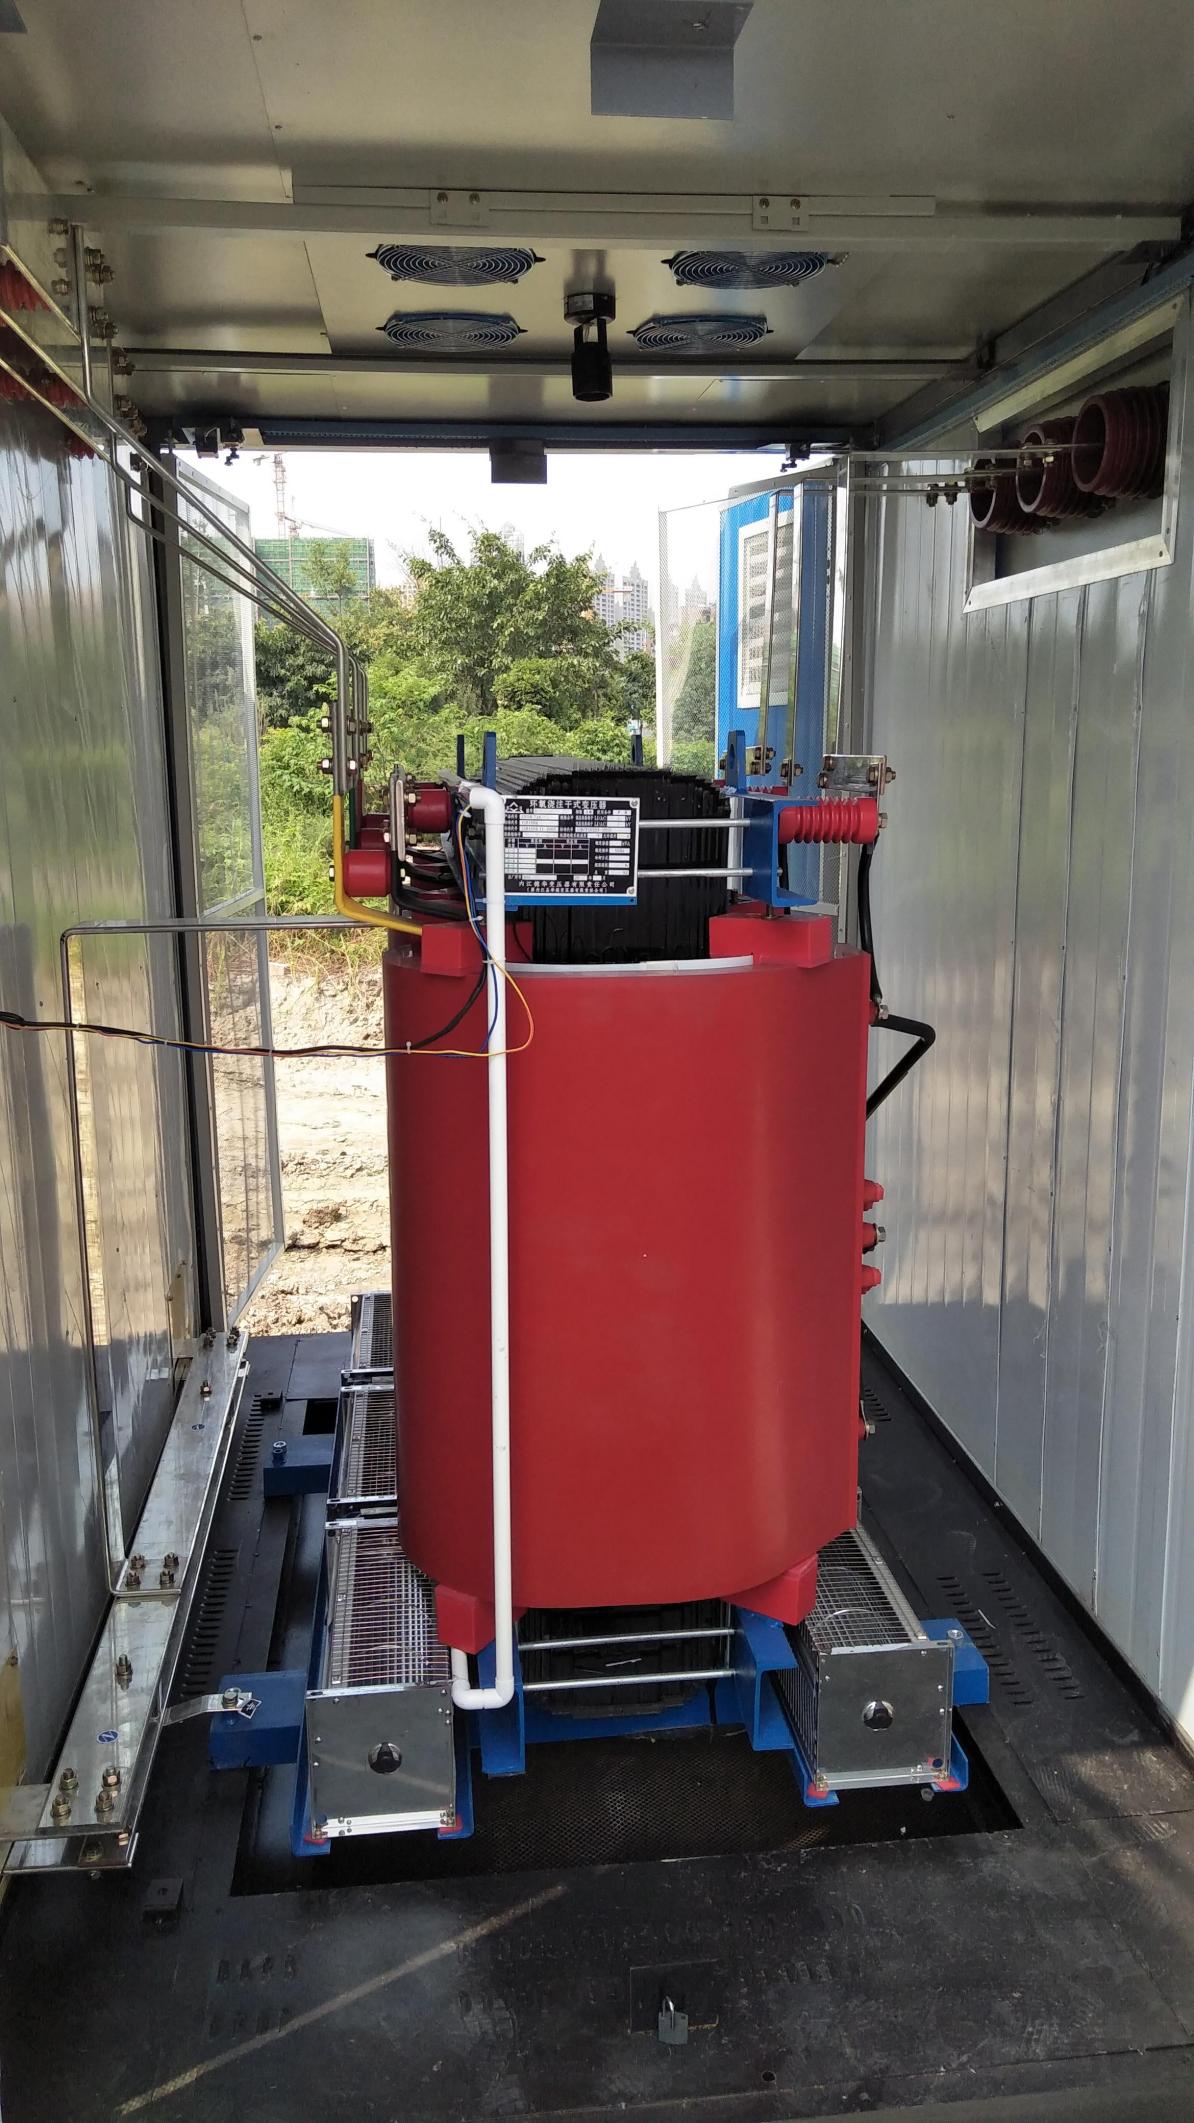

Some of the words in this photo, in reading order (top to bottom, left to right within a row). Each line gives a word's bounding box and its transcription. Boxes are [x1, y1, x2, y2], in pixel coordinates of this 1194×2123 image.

[529, 800, 607, 809] 环氧浇注干式变压器
